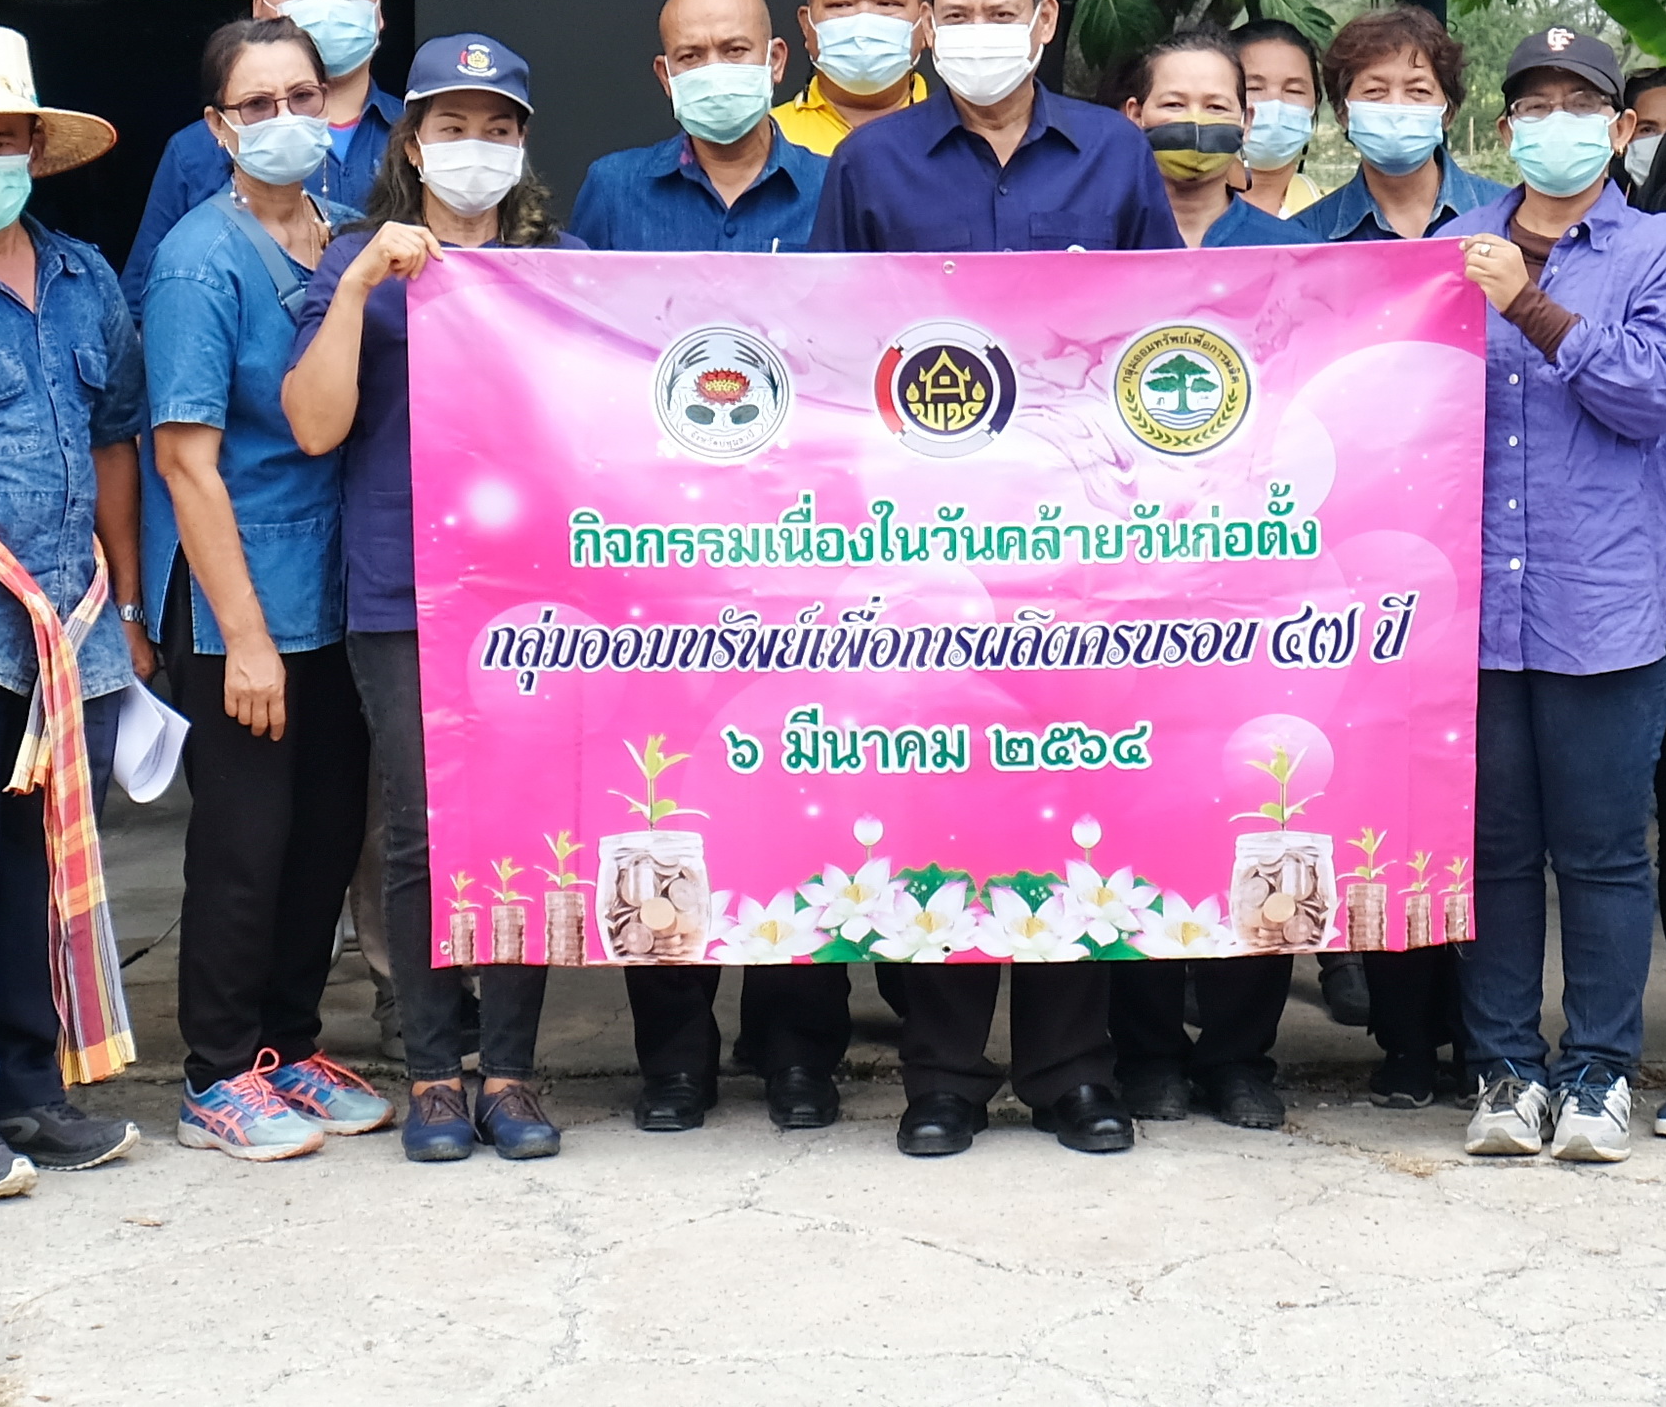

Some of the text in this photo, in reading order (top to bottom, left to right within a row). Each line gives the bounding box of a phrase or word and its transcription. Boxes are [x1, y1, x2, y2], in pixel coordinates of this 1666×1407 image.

[570, 481, 1318, 564] กิจกรรมเนื่องในวันคล้ายวันก่อตั้ง
[483, 592, 1417, 692] กลุ่มออมทรัพย์เพื่อการผลิตครบรอบ ๔๗ ปี
[725, 707, 1149, 769] ๖ มีนาคม ๒๕๖๔
